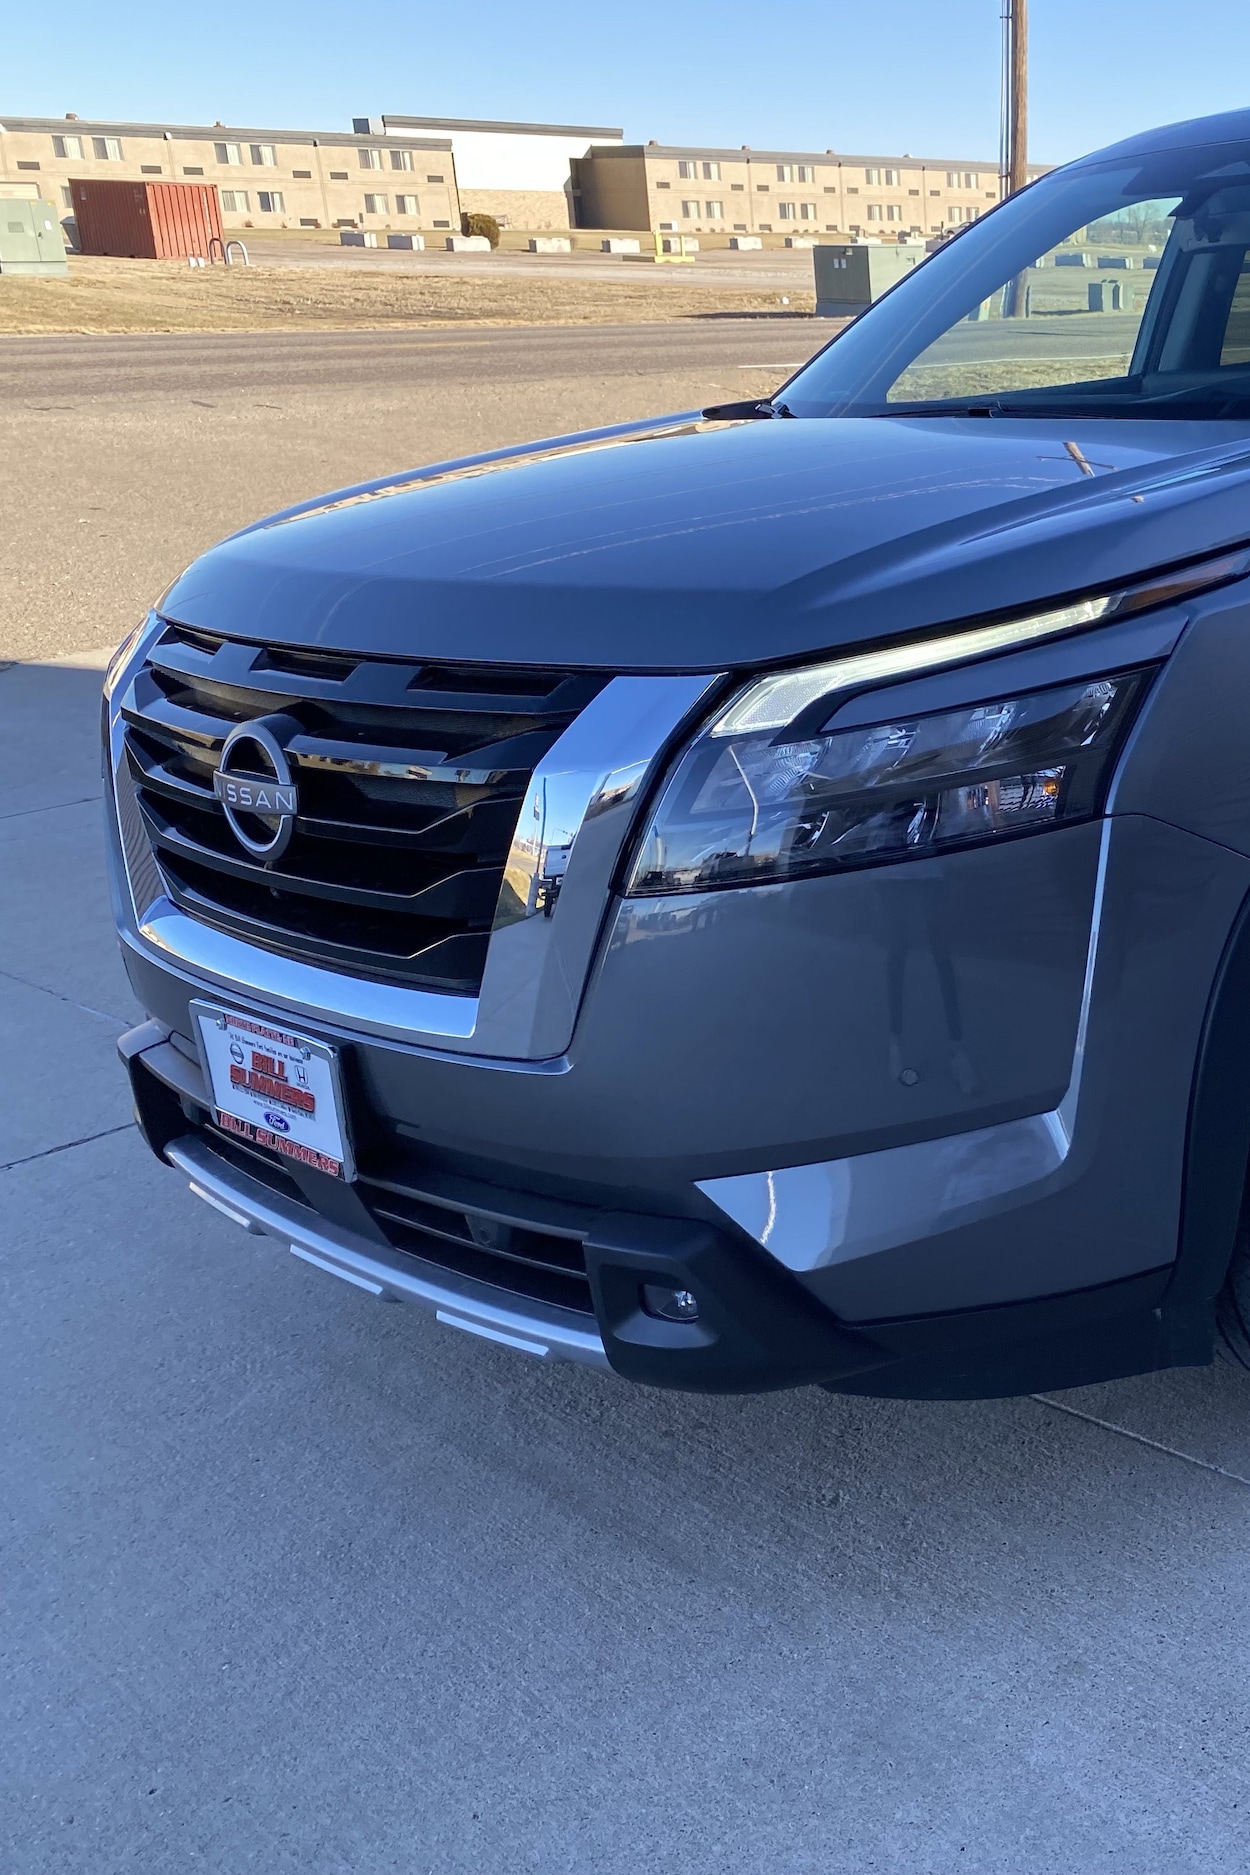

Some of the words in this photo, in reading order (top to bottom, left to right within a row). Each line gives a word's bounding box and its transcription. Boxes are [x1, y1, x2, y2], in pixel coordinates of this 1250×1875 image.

[214, 779, 293, 810] NISSAN
[251, 1050, 288, 1082] BILL
[230, 1063, 315, 1113] SUMMERS
[220, 1112, 254, 1141] BILL
[255, 1128, 340, 1177] SUMMERS
